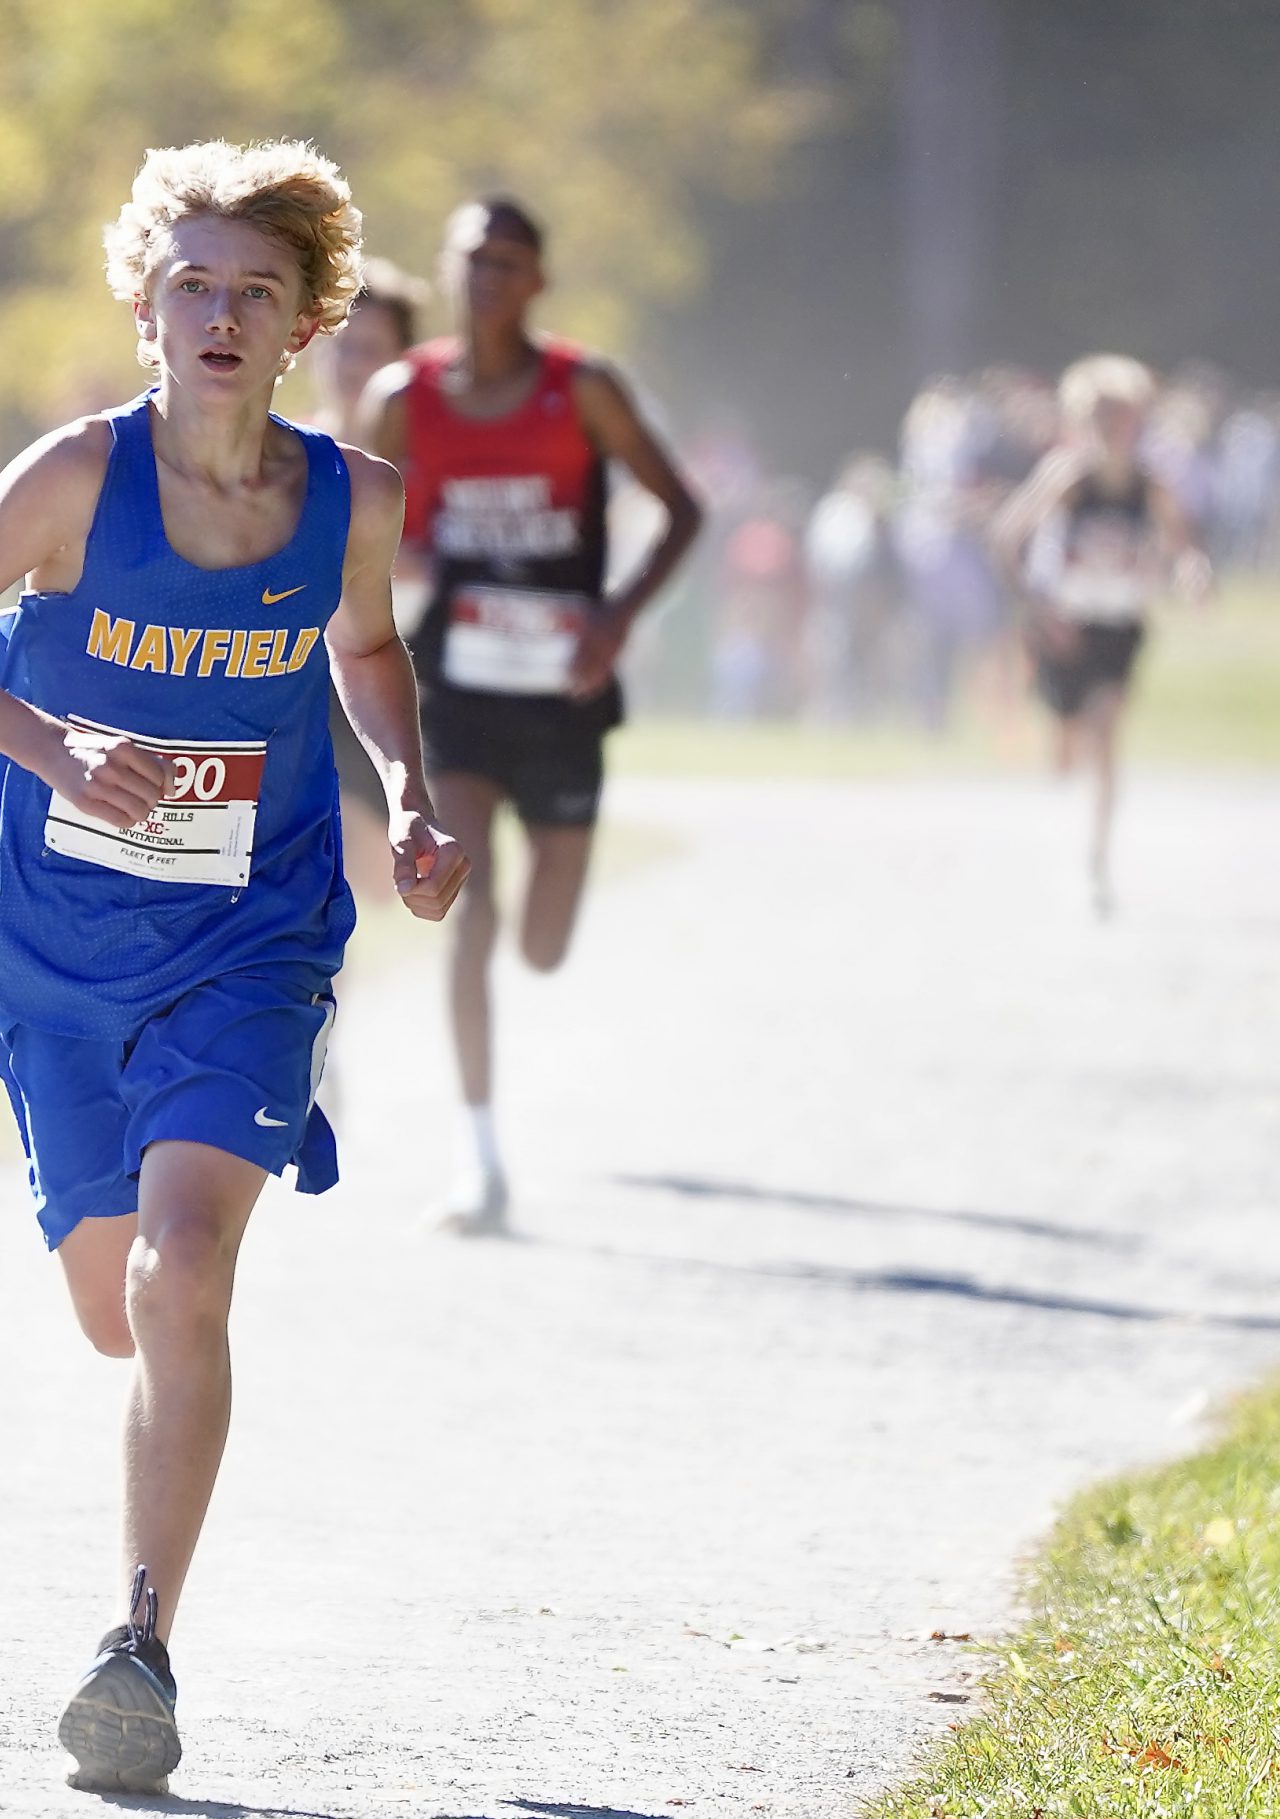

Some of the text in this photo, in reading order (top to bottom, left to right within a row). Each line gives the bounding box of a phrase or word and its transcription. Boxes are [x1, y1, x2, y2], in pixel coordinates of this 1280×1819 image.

[86, 608, 320, 678] MAYFIELD
[162, 812, 194, 822] HILLS
[118, 827, 185, 846] INVITATIONAL
[120, 847, 146, 860] FLEET
[155, 857, 177, 865] FEET
